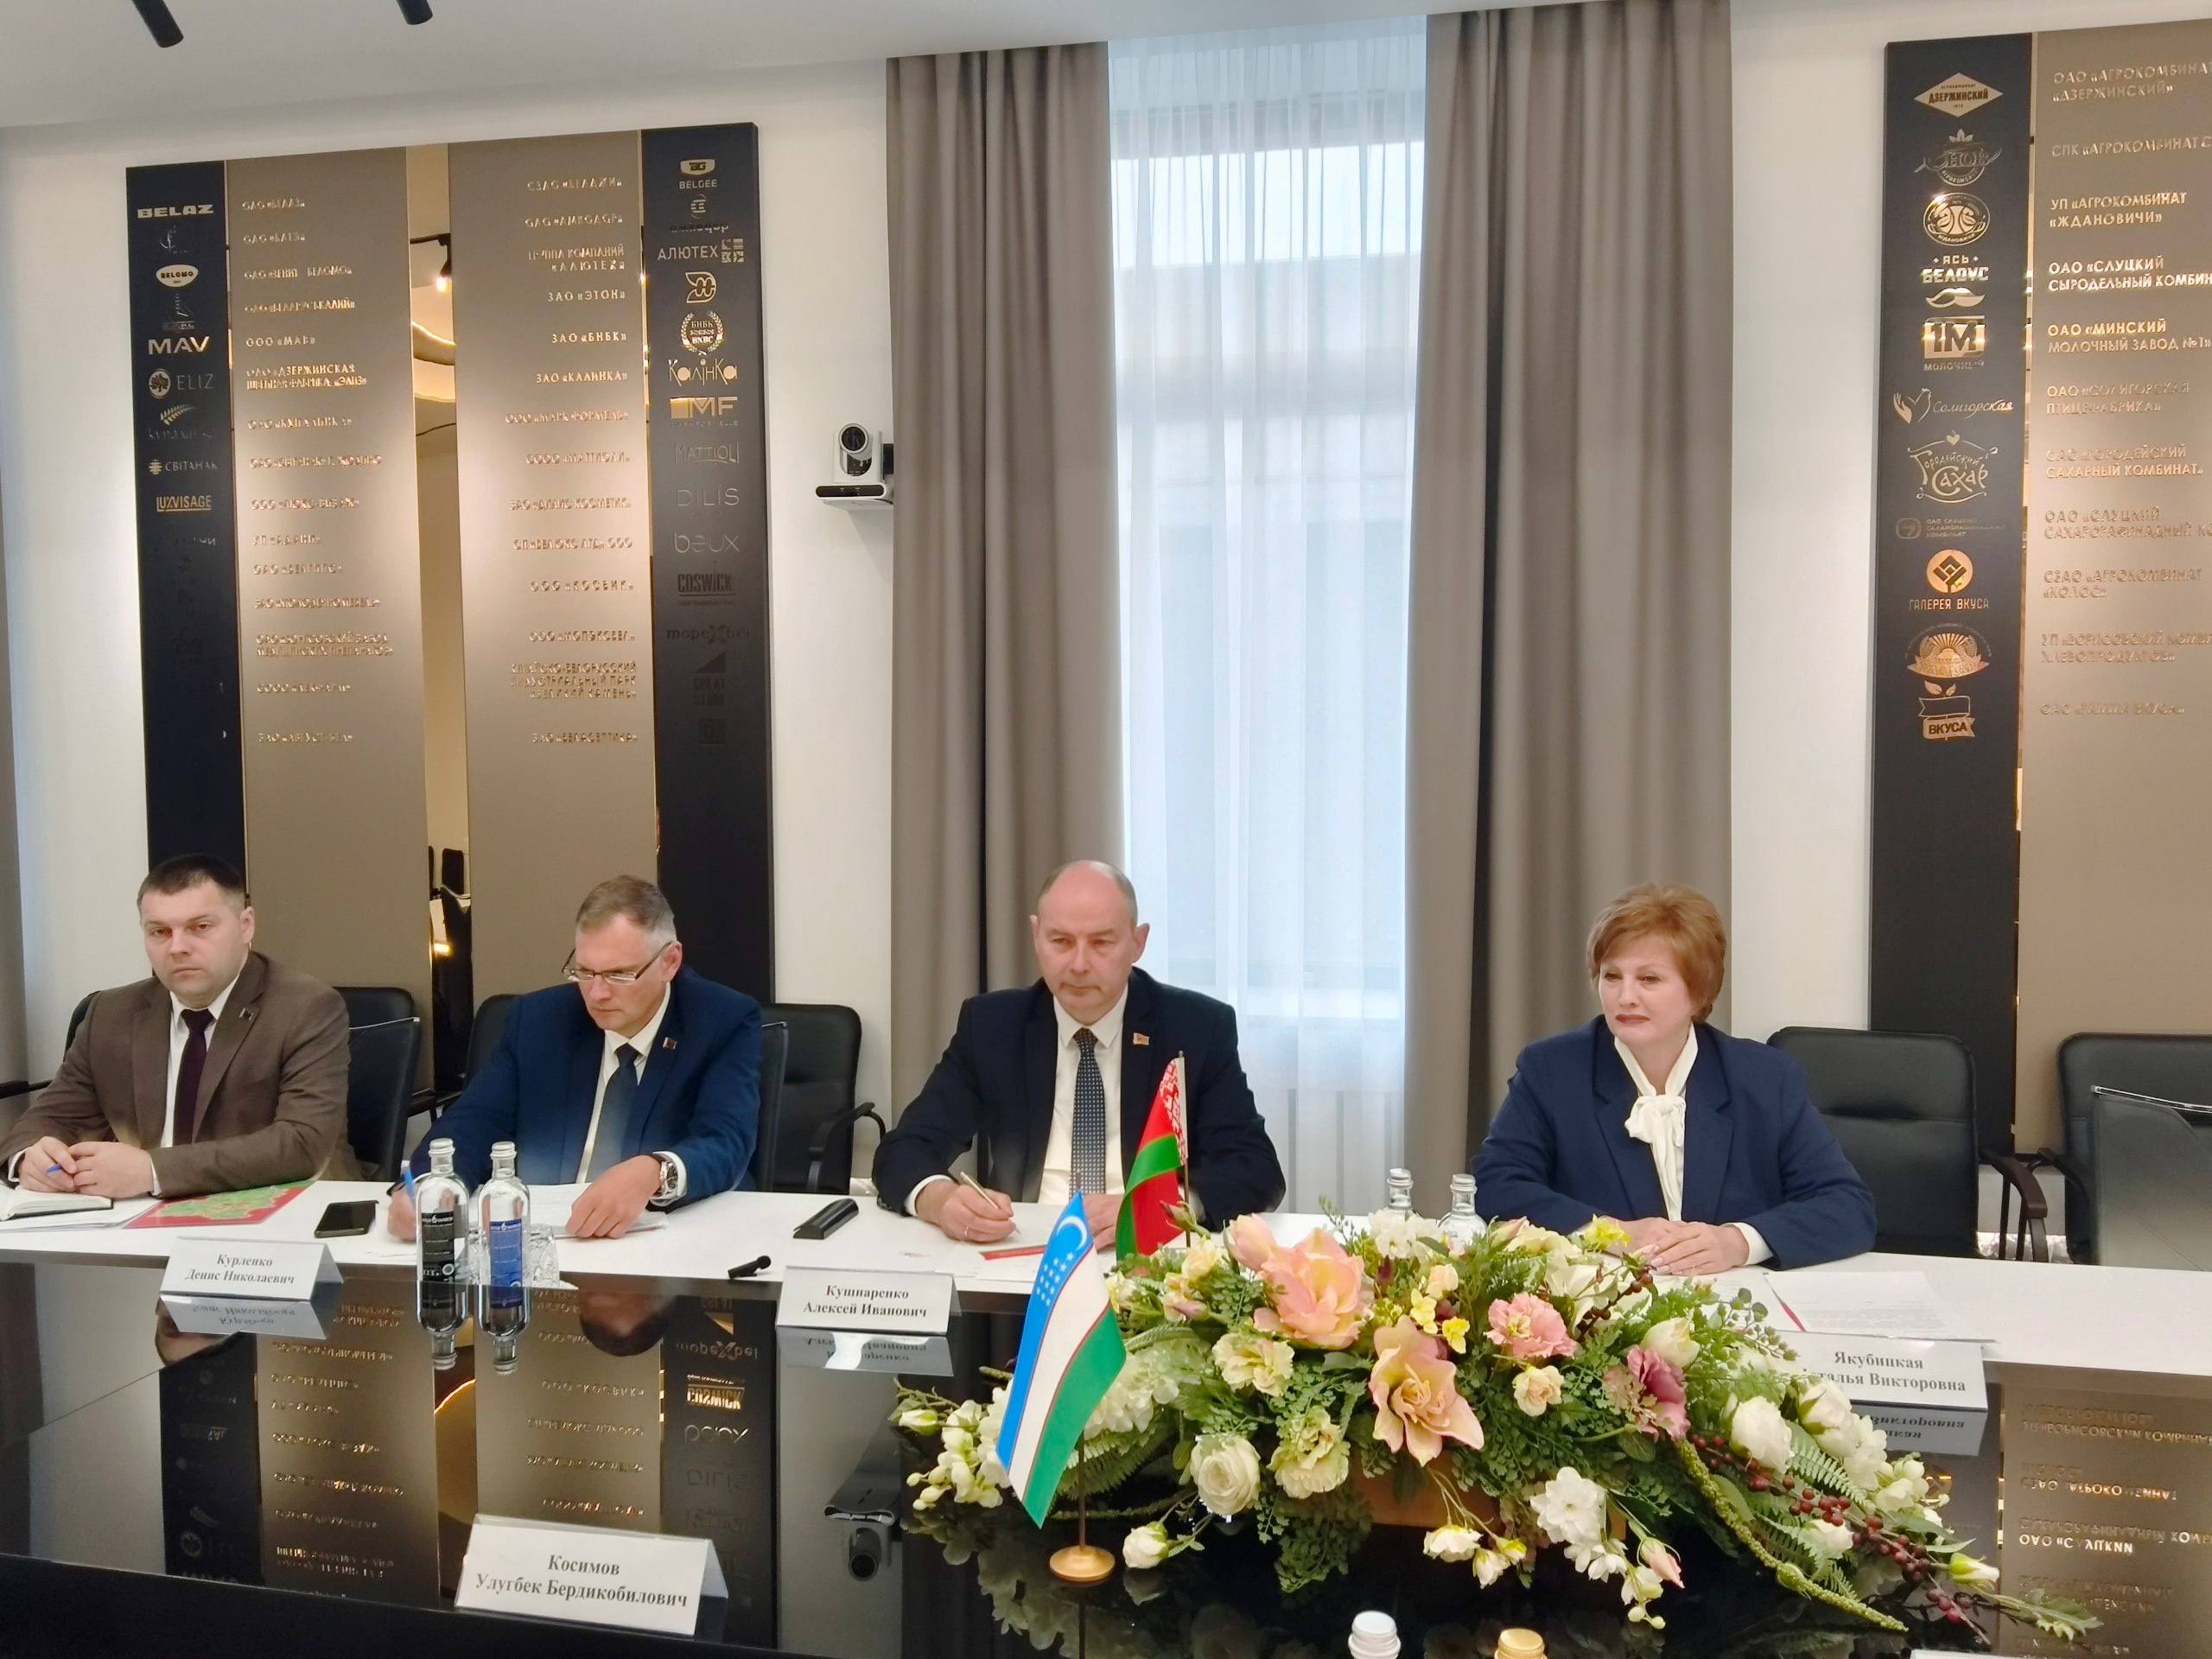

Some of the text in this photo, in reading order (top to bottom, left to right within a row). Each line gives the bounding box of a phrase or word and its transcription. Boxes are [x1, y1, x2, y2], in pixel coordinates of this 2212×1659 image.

[2053, 71, 2087, 84] ОАО
[1928, 88, 1989, 104] ДЗЕРЖИНСКИЙ
[2052, 144, 2079, 157] СПК
[2201, 136, 2212, 148] С
[678, 179, 718, 189] BELGEE
[2050, 192, 2188, 211] УП «АГРОКОМБИНАТ
[137, 204, 214, 219] BELAZ
[2049, 211, 2163, 229] «ЖДАНОВИЧИ»
[657, 245, 719, 261] АЛЮТЕХ
[1942, 254, 1969, 264] ЯСЬ
[2048, 255, 2164, 275] ОАО «СЛУЦКИЙ
[161, 270, 194, 279] BELOMO
[1922, 266, 1989, 283] БЕЛОУС
[2048, 272, 2212, 292] СЫРОДЕЛЬНЫЙ КОМБИН
[548, 291, 574, 302] ЗАО
[2047, 318, 2167, 337] ОАО «МИНСКИЙ
[148, 336, 210, 355] MAV
[245, 337, 274, 346] ООО
[552, 333, 578, 344] ЗАО
[2048, 337, 2129, 353] МОЛОЧНЫЙ
[2132, 337, 2179, 352] ЗАВОД
[176, 373, 214, 391] ELIZ
[536, 370, 629, 384] ЗАО «КАЛИНКА»
[2047, 385, 2080, 397] ОАО
[1933, 397, 2014, 420] Солигорская
[675, 441, 740, 465] MATTIOLI
[2046, 463, 2121, 479] САХАРНЫЙ
[156, 495, 212, 512] LUXVISAGE
[2045, 510, 2079, 523] ОАО
[2197, 523, 2212, 537] КО
[607, 537, 632, 549] ООО
[530, 580, 562, 592] ООО
[1909, 598, 1990, 610] ГАЛЕРЕЯ ВКУСА
[529, 631, 556, 642] ООО
[1929, 721, 1968, 734] ВКУСА
[217, 1254, 273, 1268] Курленко
[184, 1268, 296, 1284] Денис Николаевич
[825, 1285, 909, 1300] Кушнаренко
[803, 1302, 927, 1318] Алексей Иванович
[1834, 1351, 1924, 1369] Якубицкая
[1803, 1369, 1967, 1392] талья Викторовна
[548, 1554, 620, 1576] Косимов
[475, 1573, 689, 1607] Улугбек Бердикобилович
